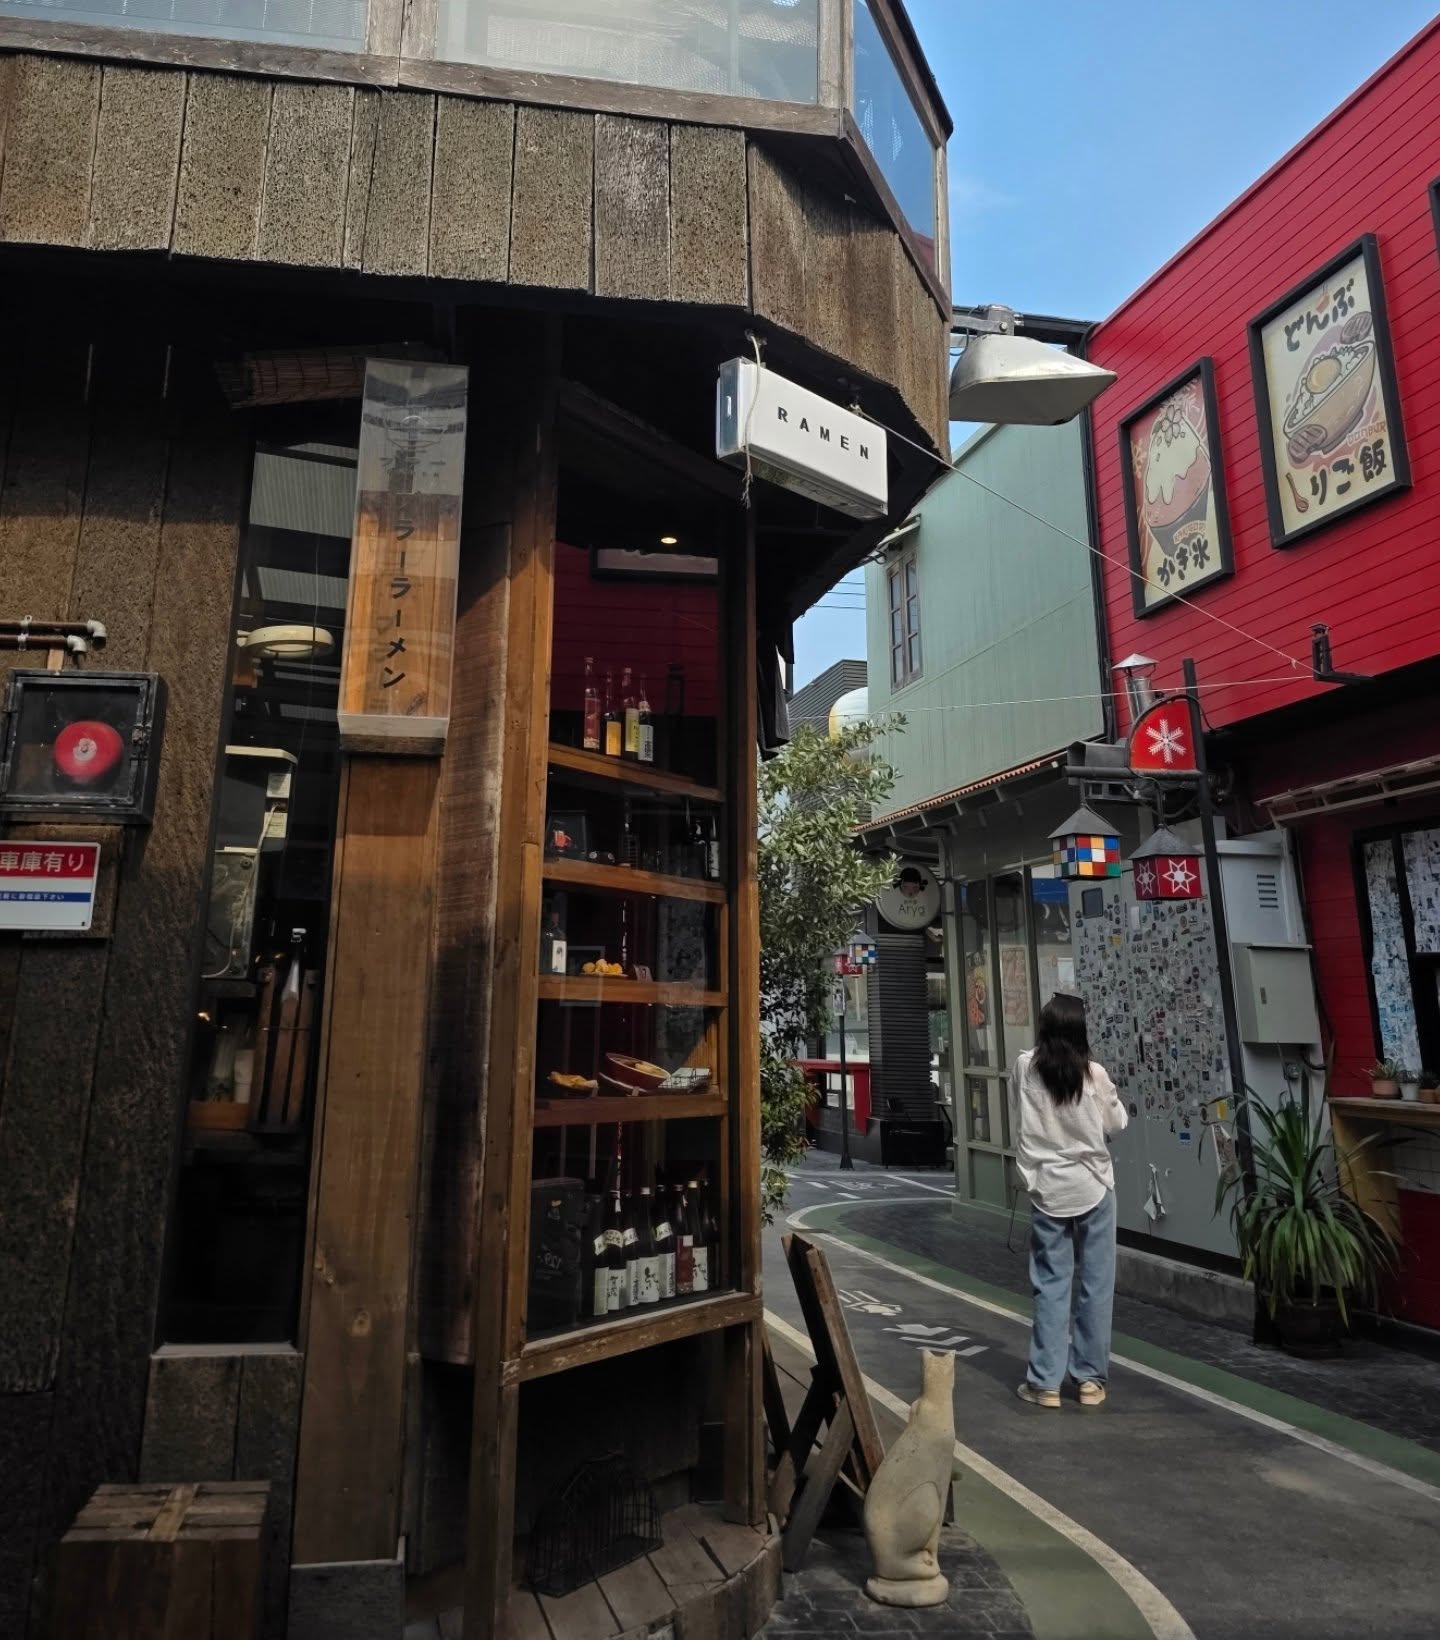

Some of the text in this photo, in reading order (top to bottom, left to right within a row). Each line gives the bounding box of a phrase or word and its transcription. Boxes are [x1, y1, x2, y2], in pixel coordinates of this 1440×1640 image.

[1284, 278, 1355, 352] どんぶ
[777, 406, 869, 460] RAMEN
[1310, 439, 1386, 506] りご飯
[1157, 537, 1210, 586] かき氷
[0, 851, 84, 872] 車庫有り
